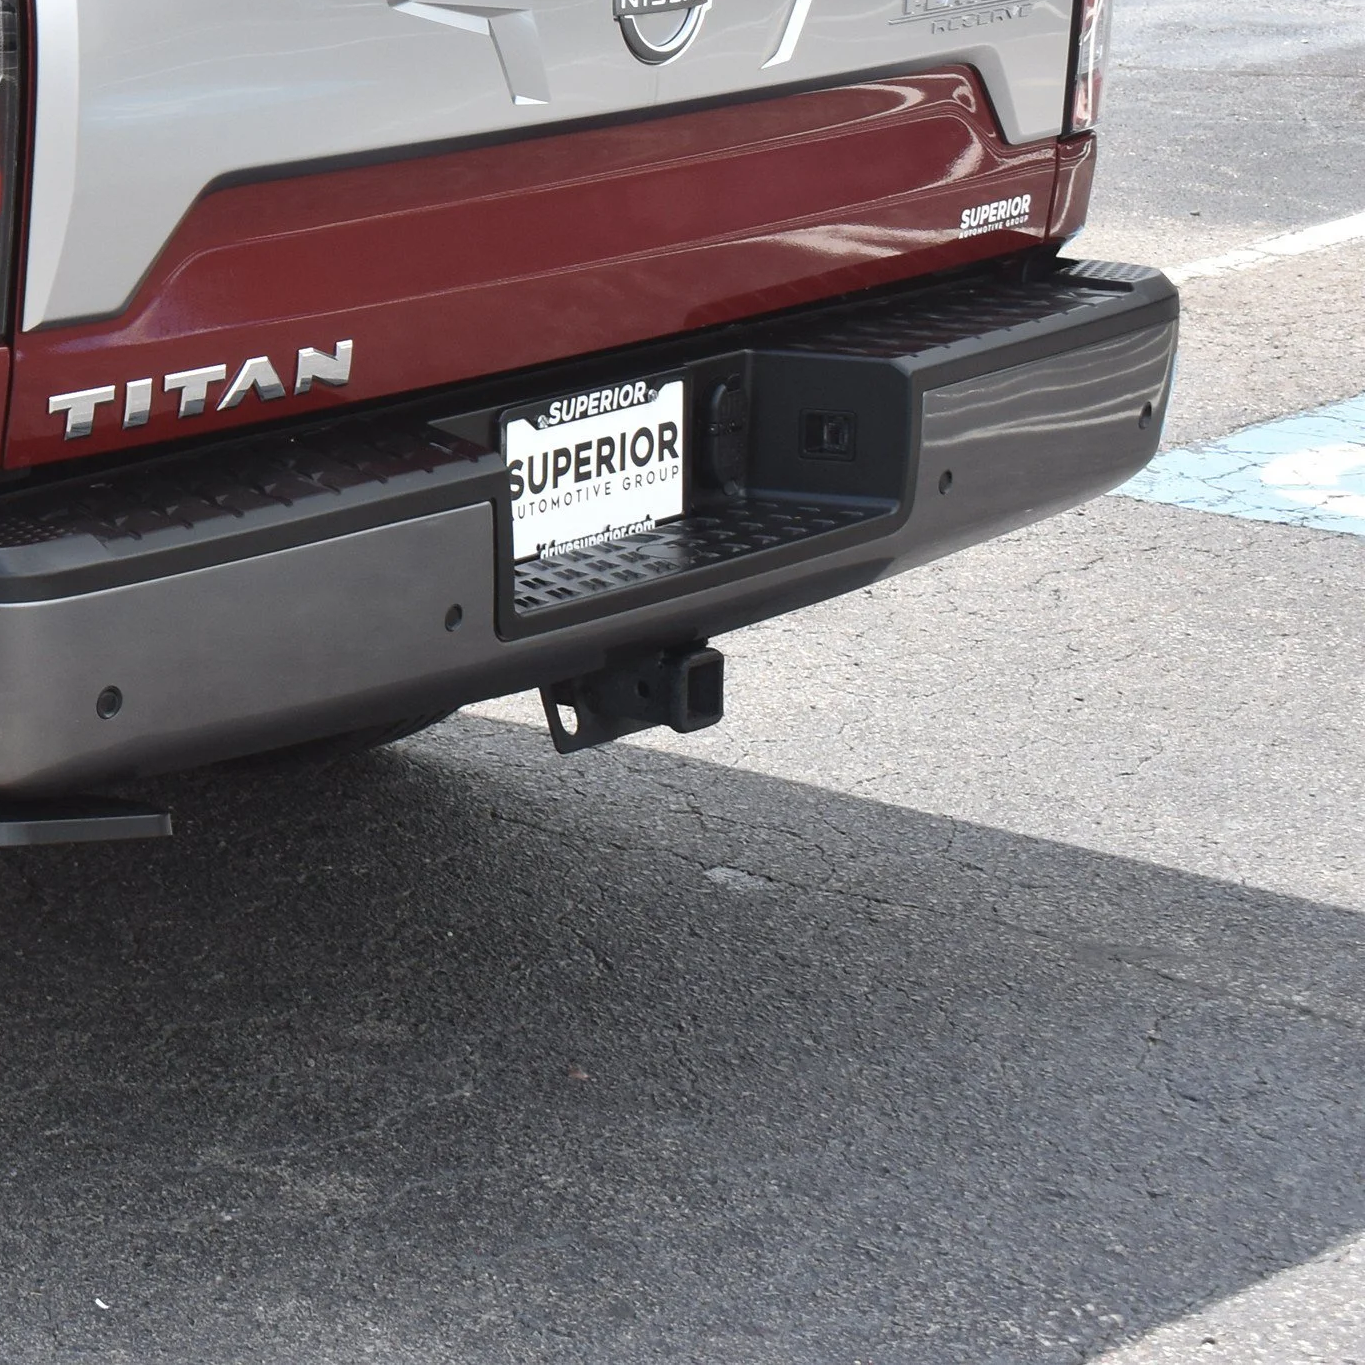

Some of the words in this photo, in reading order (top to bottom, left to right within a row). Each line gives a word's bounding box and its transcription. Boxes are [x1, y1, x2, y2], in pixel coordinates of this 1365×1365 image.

[931, 3, 1034, 34] RESERVE
[958, 221, 1004, 239] AUTOMOTIVE
[1005, 215, 1029, 227] GROUP
[960, 194, 1031, 229] SUPERIOR
[49, 339, 353, 440] TITAN
[548, 381, 646, 425] SUPERIOR
[508, 421, 679, 501] SUPERIOR
[512, 481, 612, 521] UTOMOTIVE
[622, 465, 679, 491] GROUP
